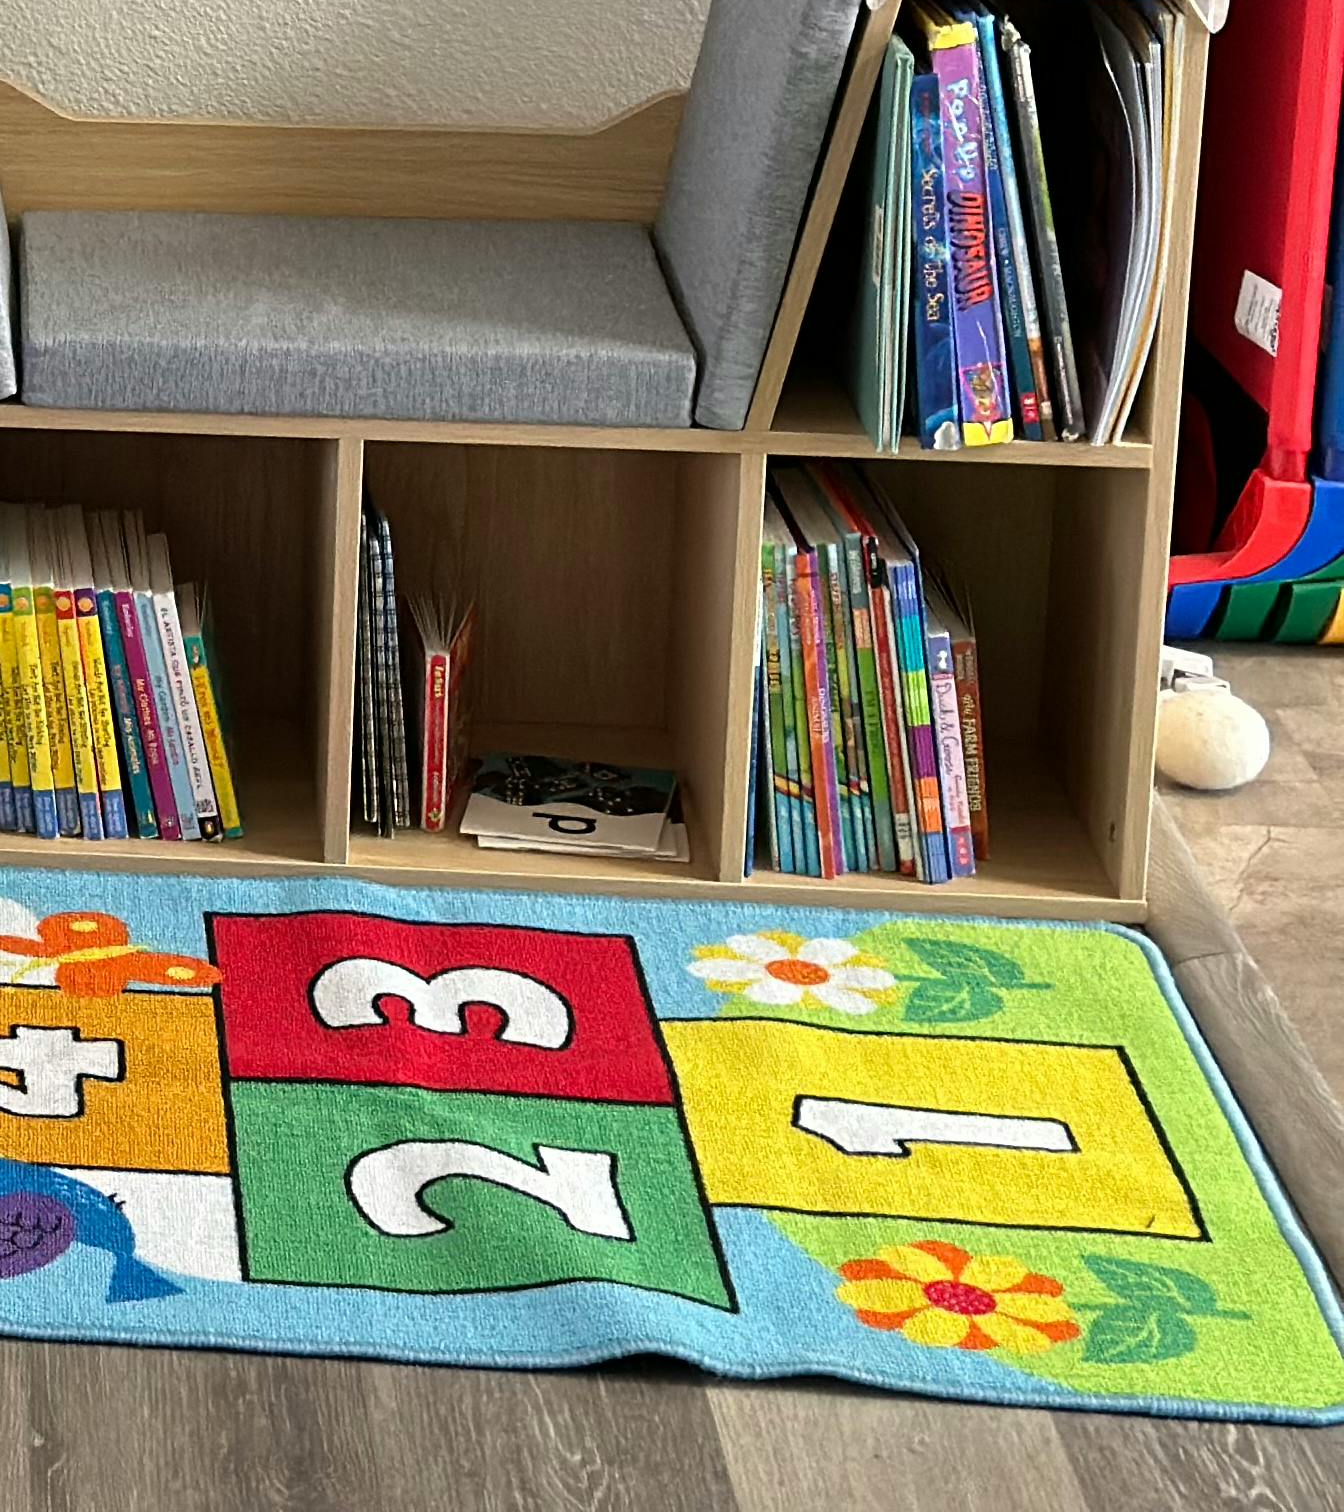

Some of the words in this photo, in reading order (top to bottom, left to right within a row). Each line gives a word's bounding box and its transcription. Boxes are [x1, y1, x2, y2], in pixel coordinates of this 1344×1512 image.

[917, 168, 941, 230] Secrets
[924, 259, 944, 288] the
[946, 189, 996, 312] DINOSAUR
[925, 292, 946, 321] Sea
[160, 607, 170, 619] EL
[163, 620, 178, 657] ARTISTA
[171, 659, 182, 677] QUE
[962, 717, 980, 755] FARM
[963, 757, 985, 812] FRIENDS
[311, 955, 571, 1052] 3
[792, 1093, 1078, 1155] 1
[344, 1138, 636, 1245] 2
